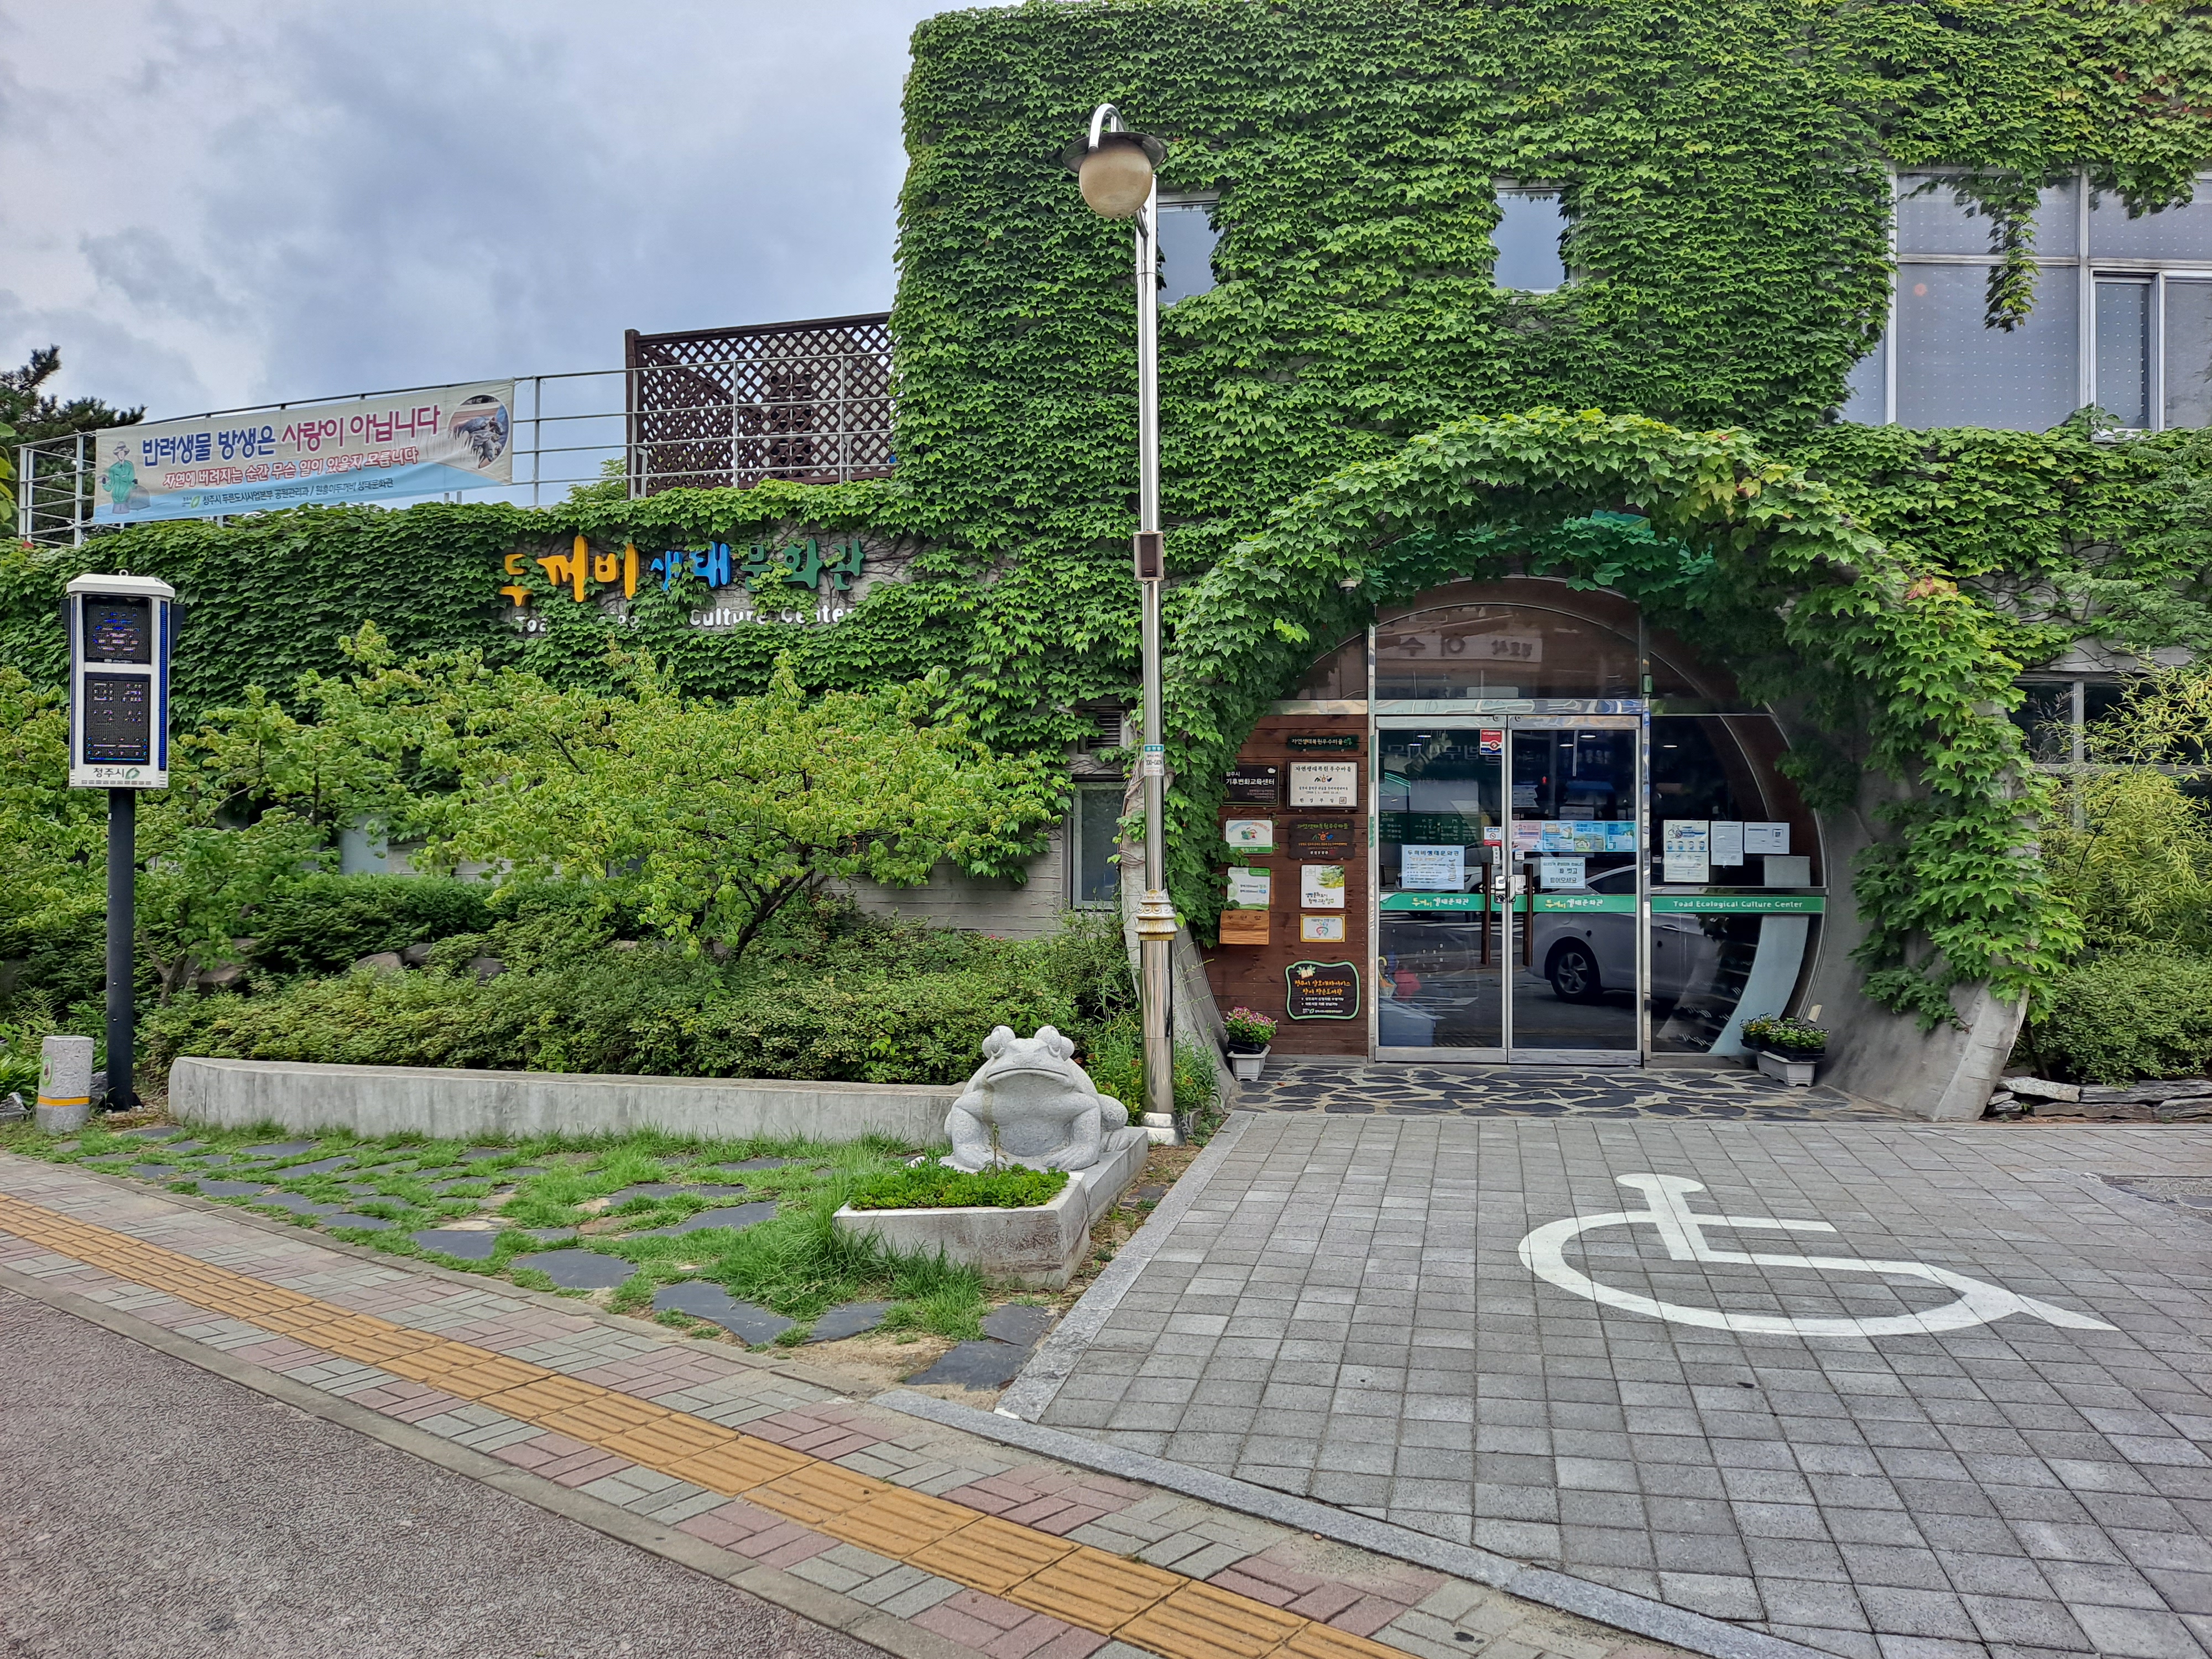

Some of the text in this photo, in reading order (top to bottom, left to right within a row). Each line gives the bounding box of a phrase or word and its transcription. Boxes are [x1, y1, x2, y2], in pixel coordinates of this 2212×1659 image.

[142, 405, 441, 467] 반려생물 방생은 사랑이 아닙니다
[163, 446, 419, 489] 자연에 버려지는 순간 무슨 일이 있을지 모릅니다
[203, 494, 221, 505] 청주시
[222, 490, 274, 504] 푸른도시사업본부
[275, 485, 310, 499] 공원관리과
[93, 768, 124, 778] 청주시
[1412, 896, 1469, 907] 두꺼비 생태문화관
[1545, 898, 1604, 909] 두꺼비 생태문화관
[1696, 900, 1738, 909] Ecological
